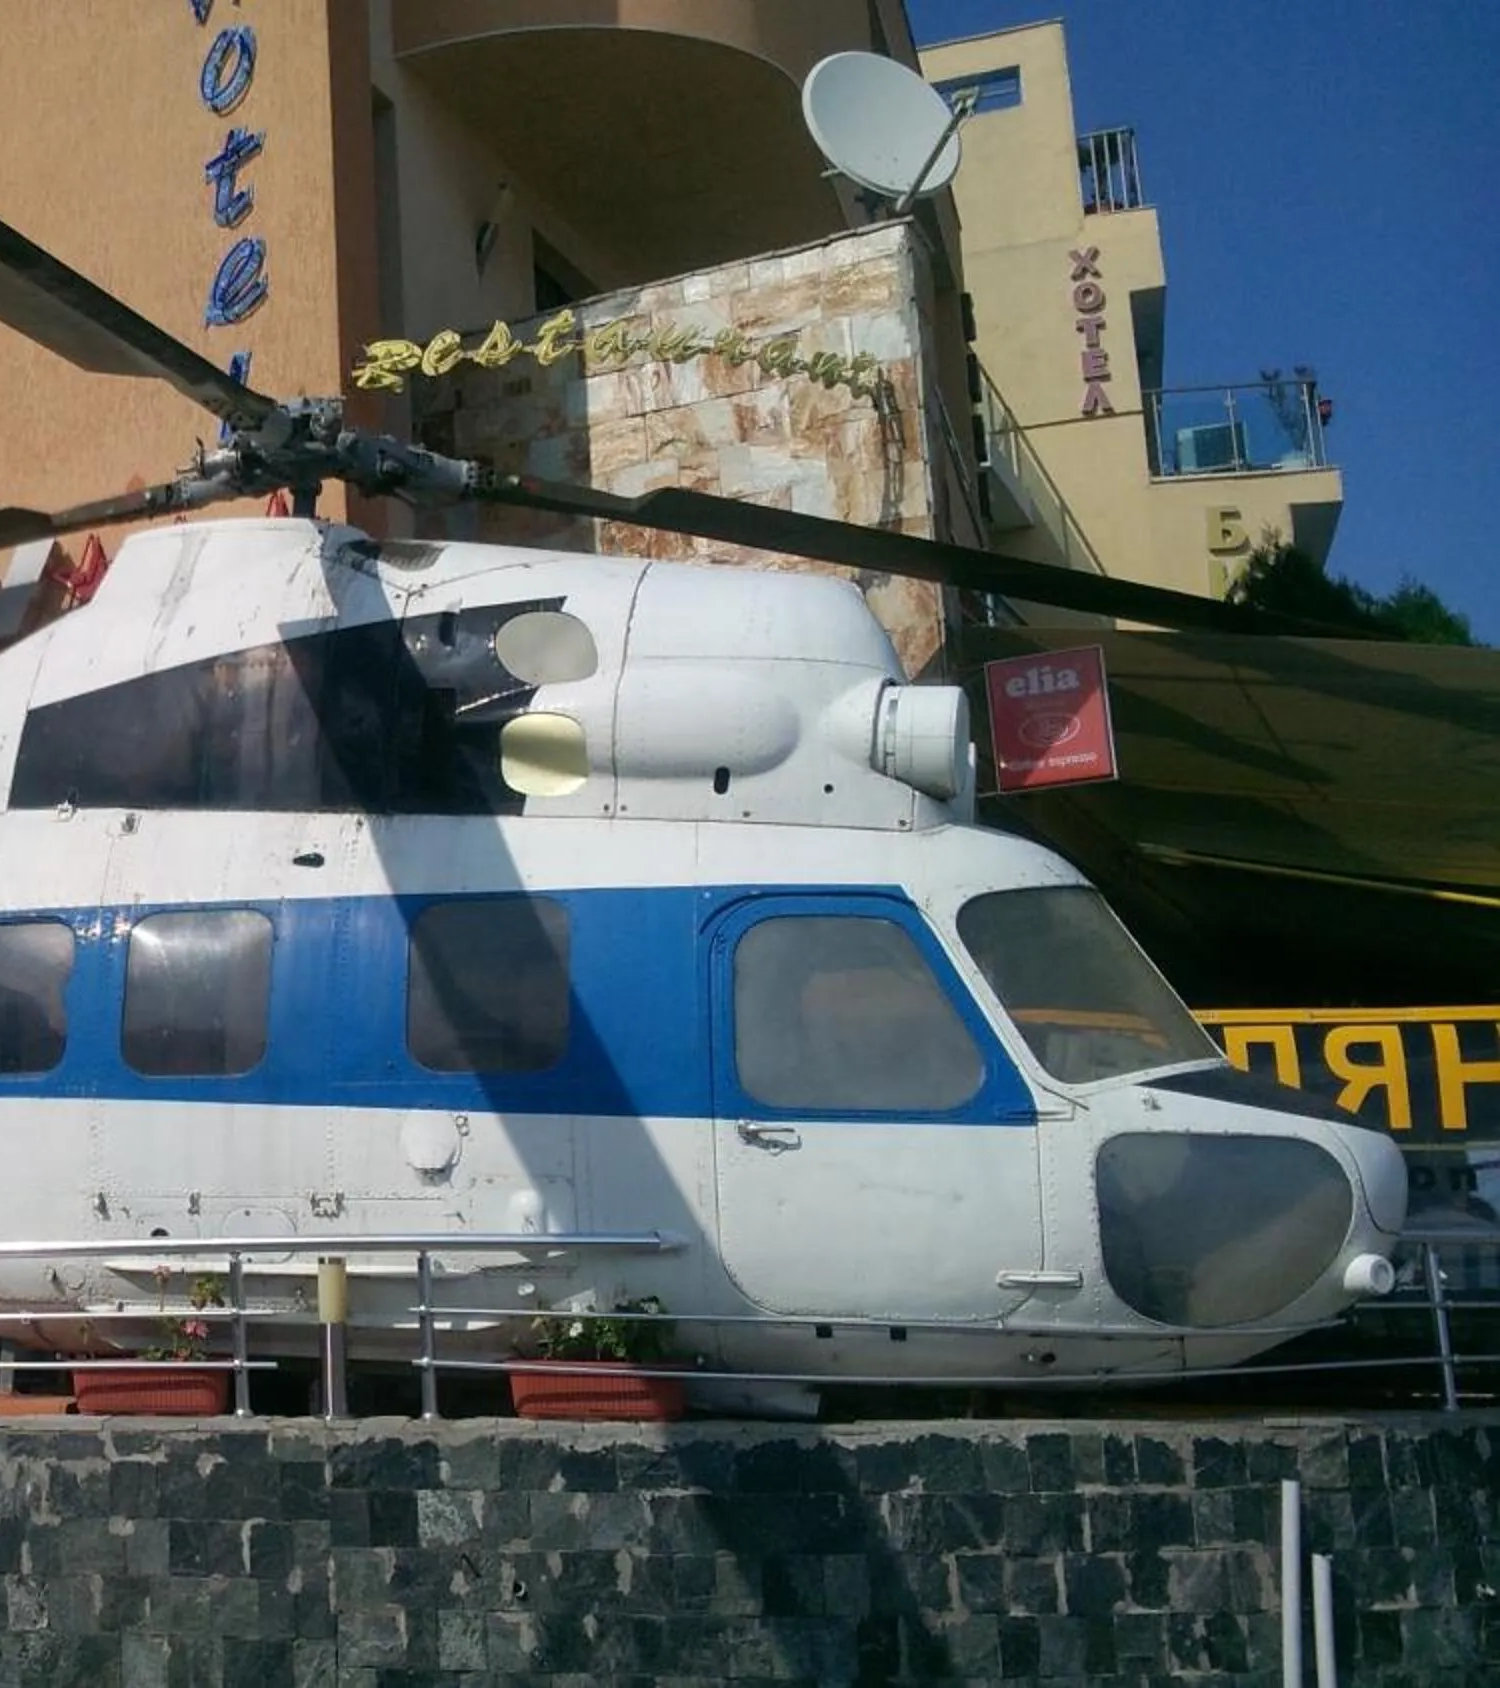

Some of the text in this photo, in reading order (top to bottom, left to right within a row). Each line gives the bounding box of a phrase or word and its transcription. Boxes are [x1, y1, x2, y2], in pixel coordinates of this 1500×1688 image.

[188, 0, 269, 442] otel
[1068, 246, 1114, 416] ХОТЕЛ
[1005, 665, 1081, 698] elia
